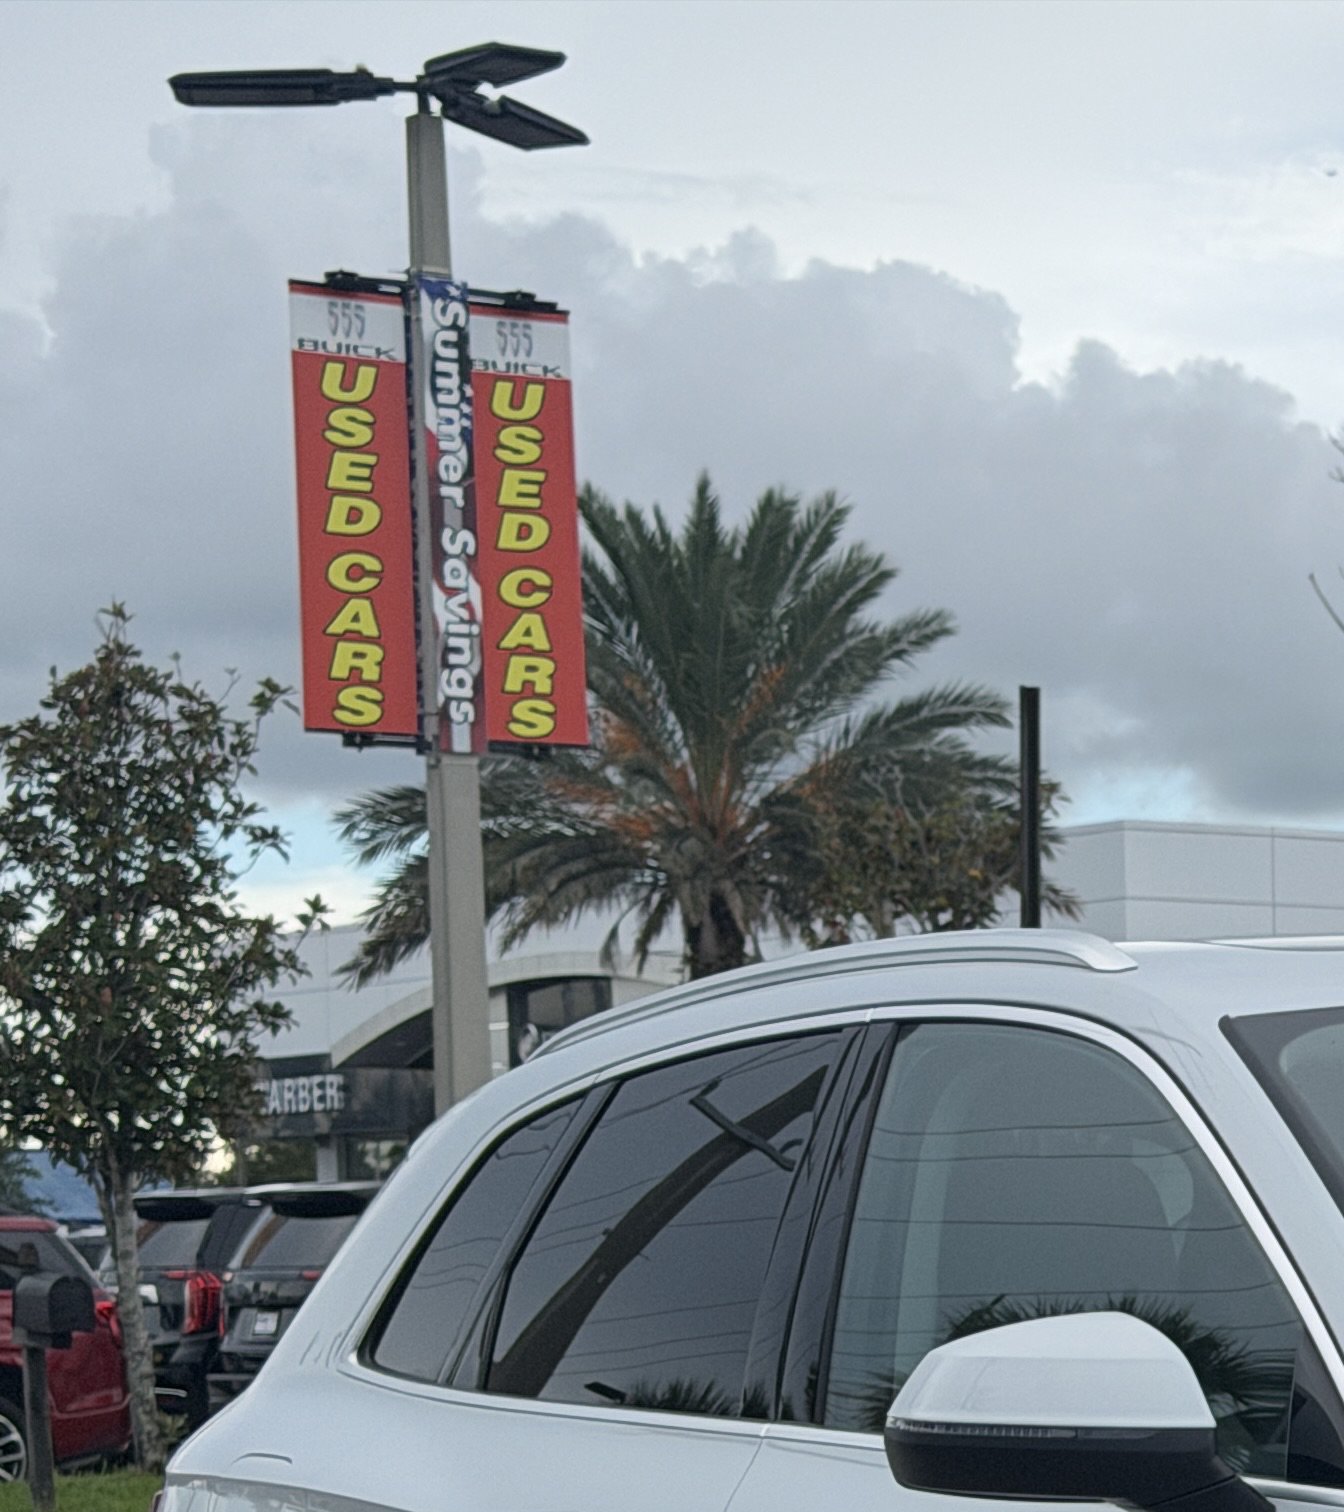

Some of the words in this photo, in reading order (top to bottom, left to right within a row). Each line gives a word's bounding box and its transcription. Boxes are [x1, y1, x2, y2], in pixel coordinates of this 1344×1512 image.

[298, 338, 397, 361] BUICK
[433, 299, 466, 509] Summer
[320, 361, 382, 536] USED
[490, 380, 551, 552] USED
[324, 551, 384, 726] CARS
[441, 528, 476, 725] Savings
[497, 566, 556, 738] CARS
[253, 1073, 344, 1116] ARBER
